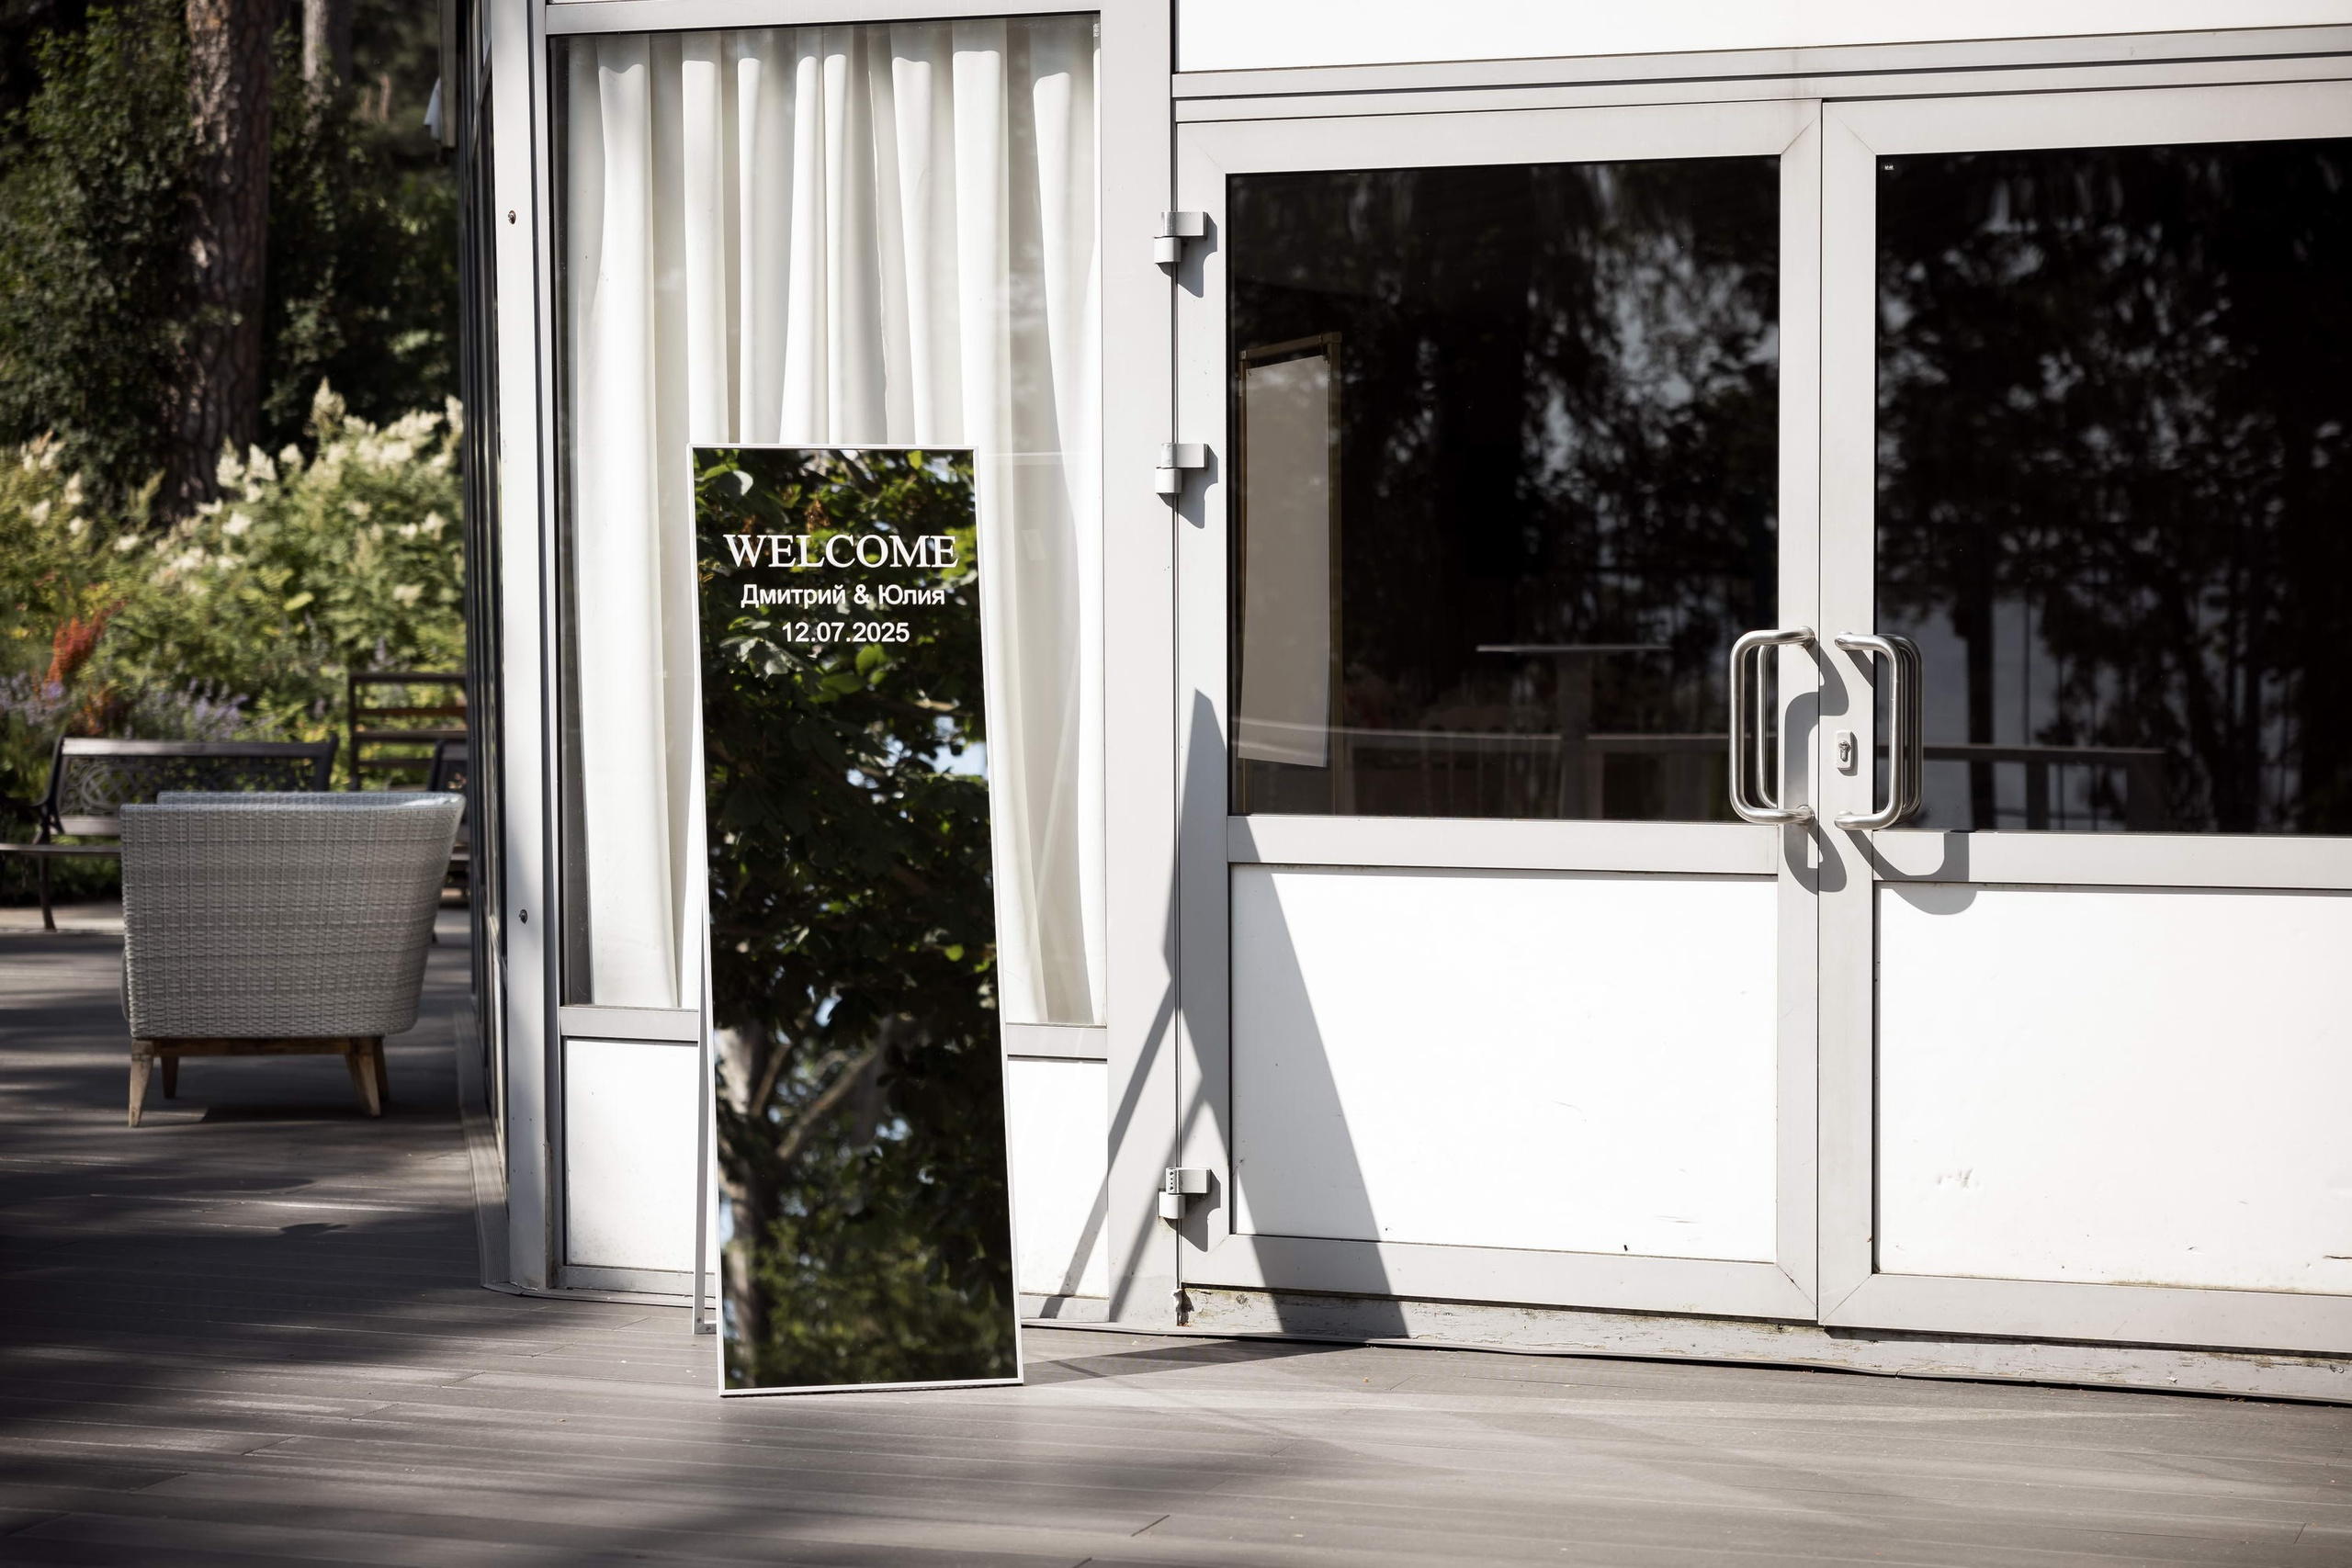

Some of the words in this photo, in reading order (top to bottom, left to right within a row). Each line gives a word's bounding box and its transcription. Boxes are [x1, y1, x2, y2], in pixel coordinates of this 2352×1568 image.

[723, 534, 959, 568] WELCOME
[741, 584, 846, 609] Дмитрий
[854, 584, 871, 605] &
[878, 584, 945, 605] Юлия
[782, 622, 910, 643] 12.07.2025
